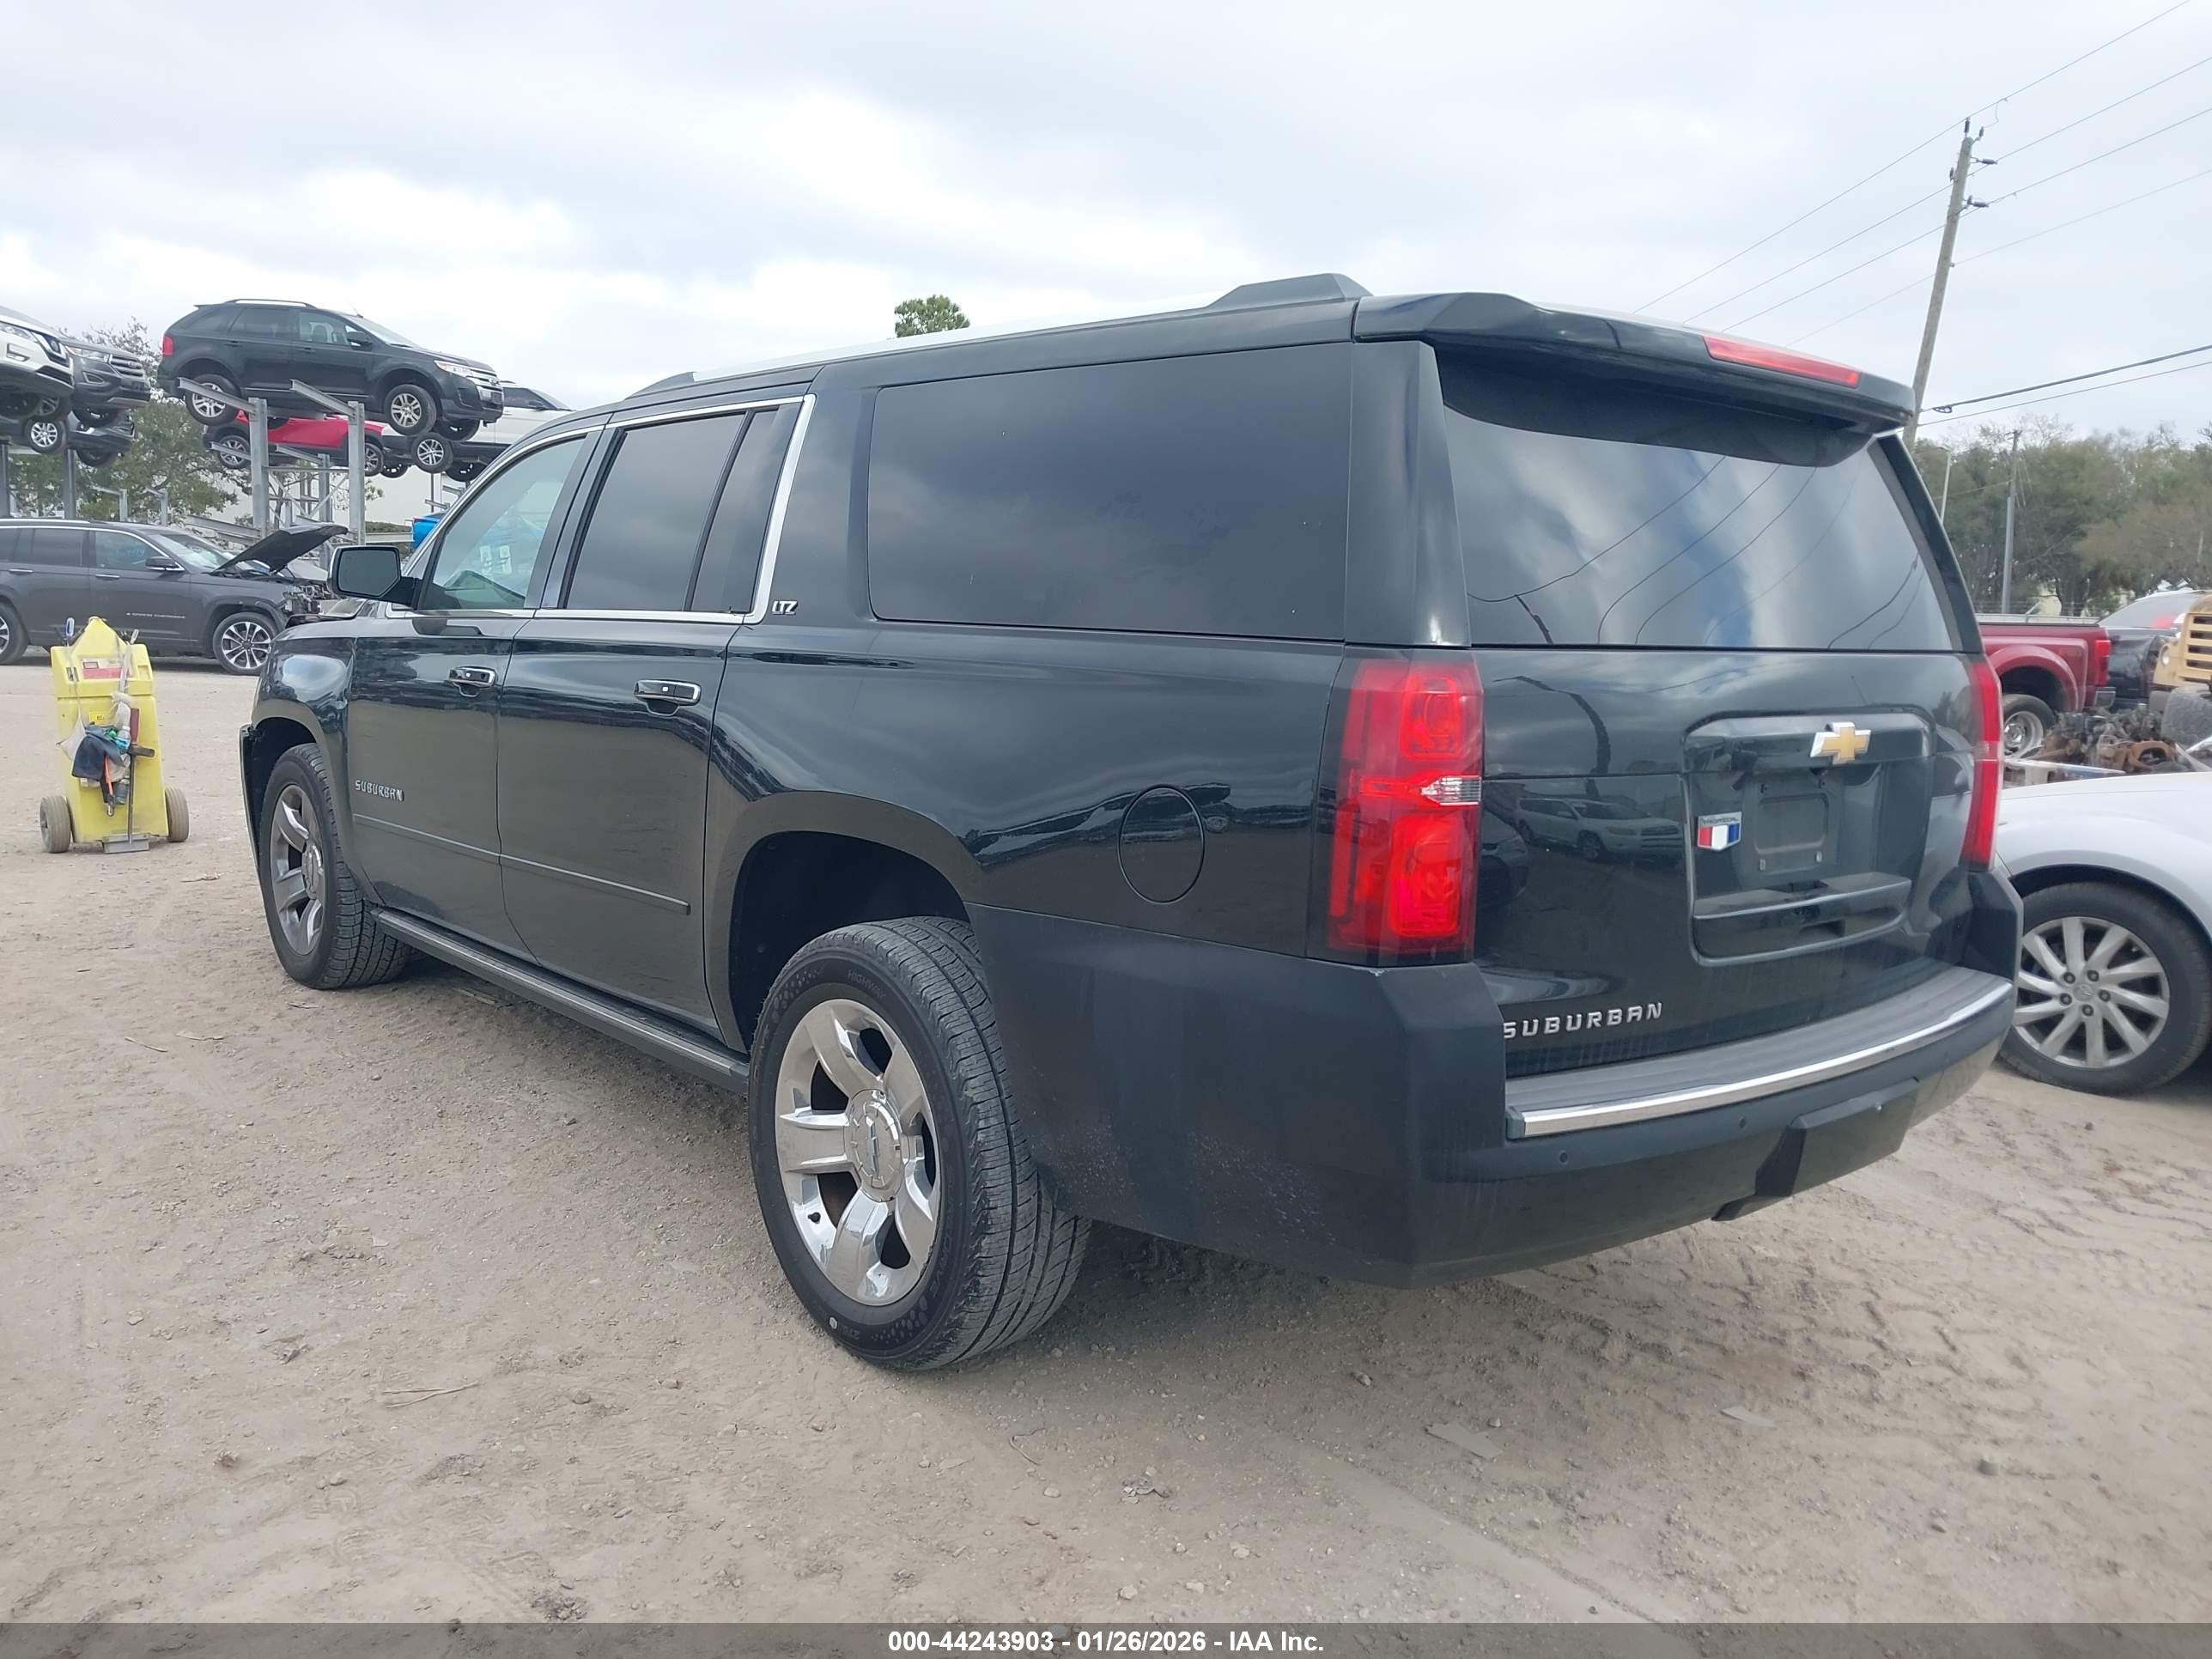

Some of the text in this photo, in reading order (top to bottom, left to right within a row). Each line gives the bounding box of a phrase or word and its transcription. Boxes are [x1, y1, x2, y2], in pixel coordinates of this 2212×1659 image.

[771, 600, 799, 616] LTZ
[355, 780, 405, 802] SUBURBAN
[1503, 1002, 1662, 1039] SUBURBAN
